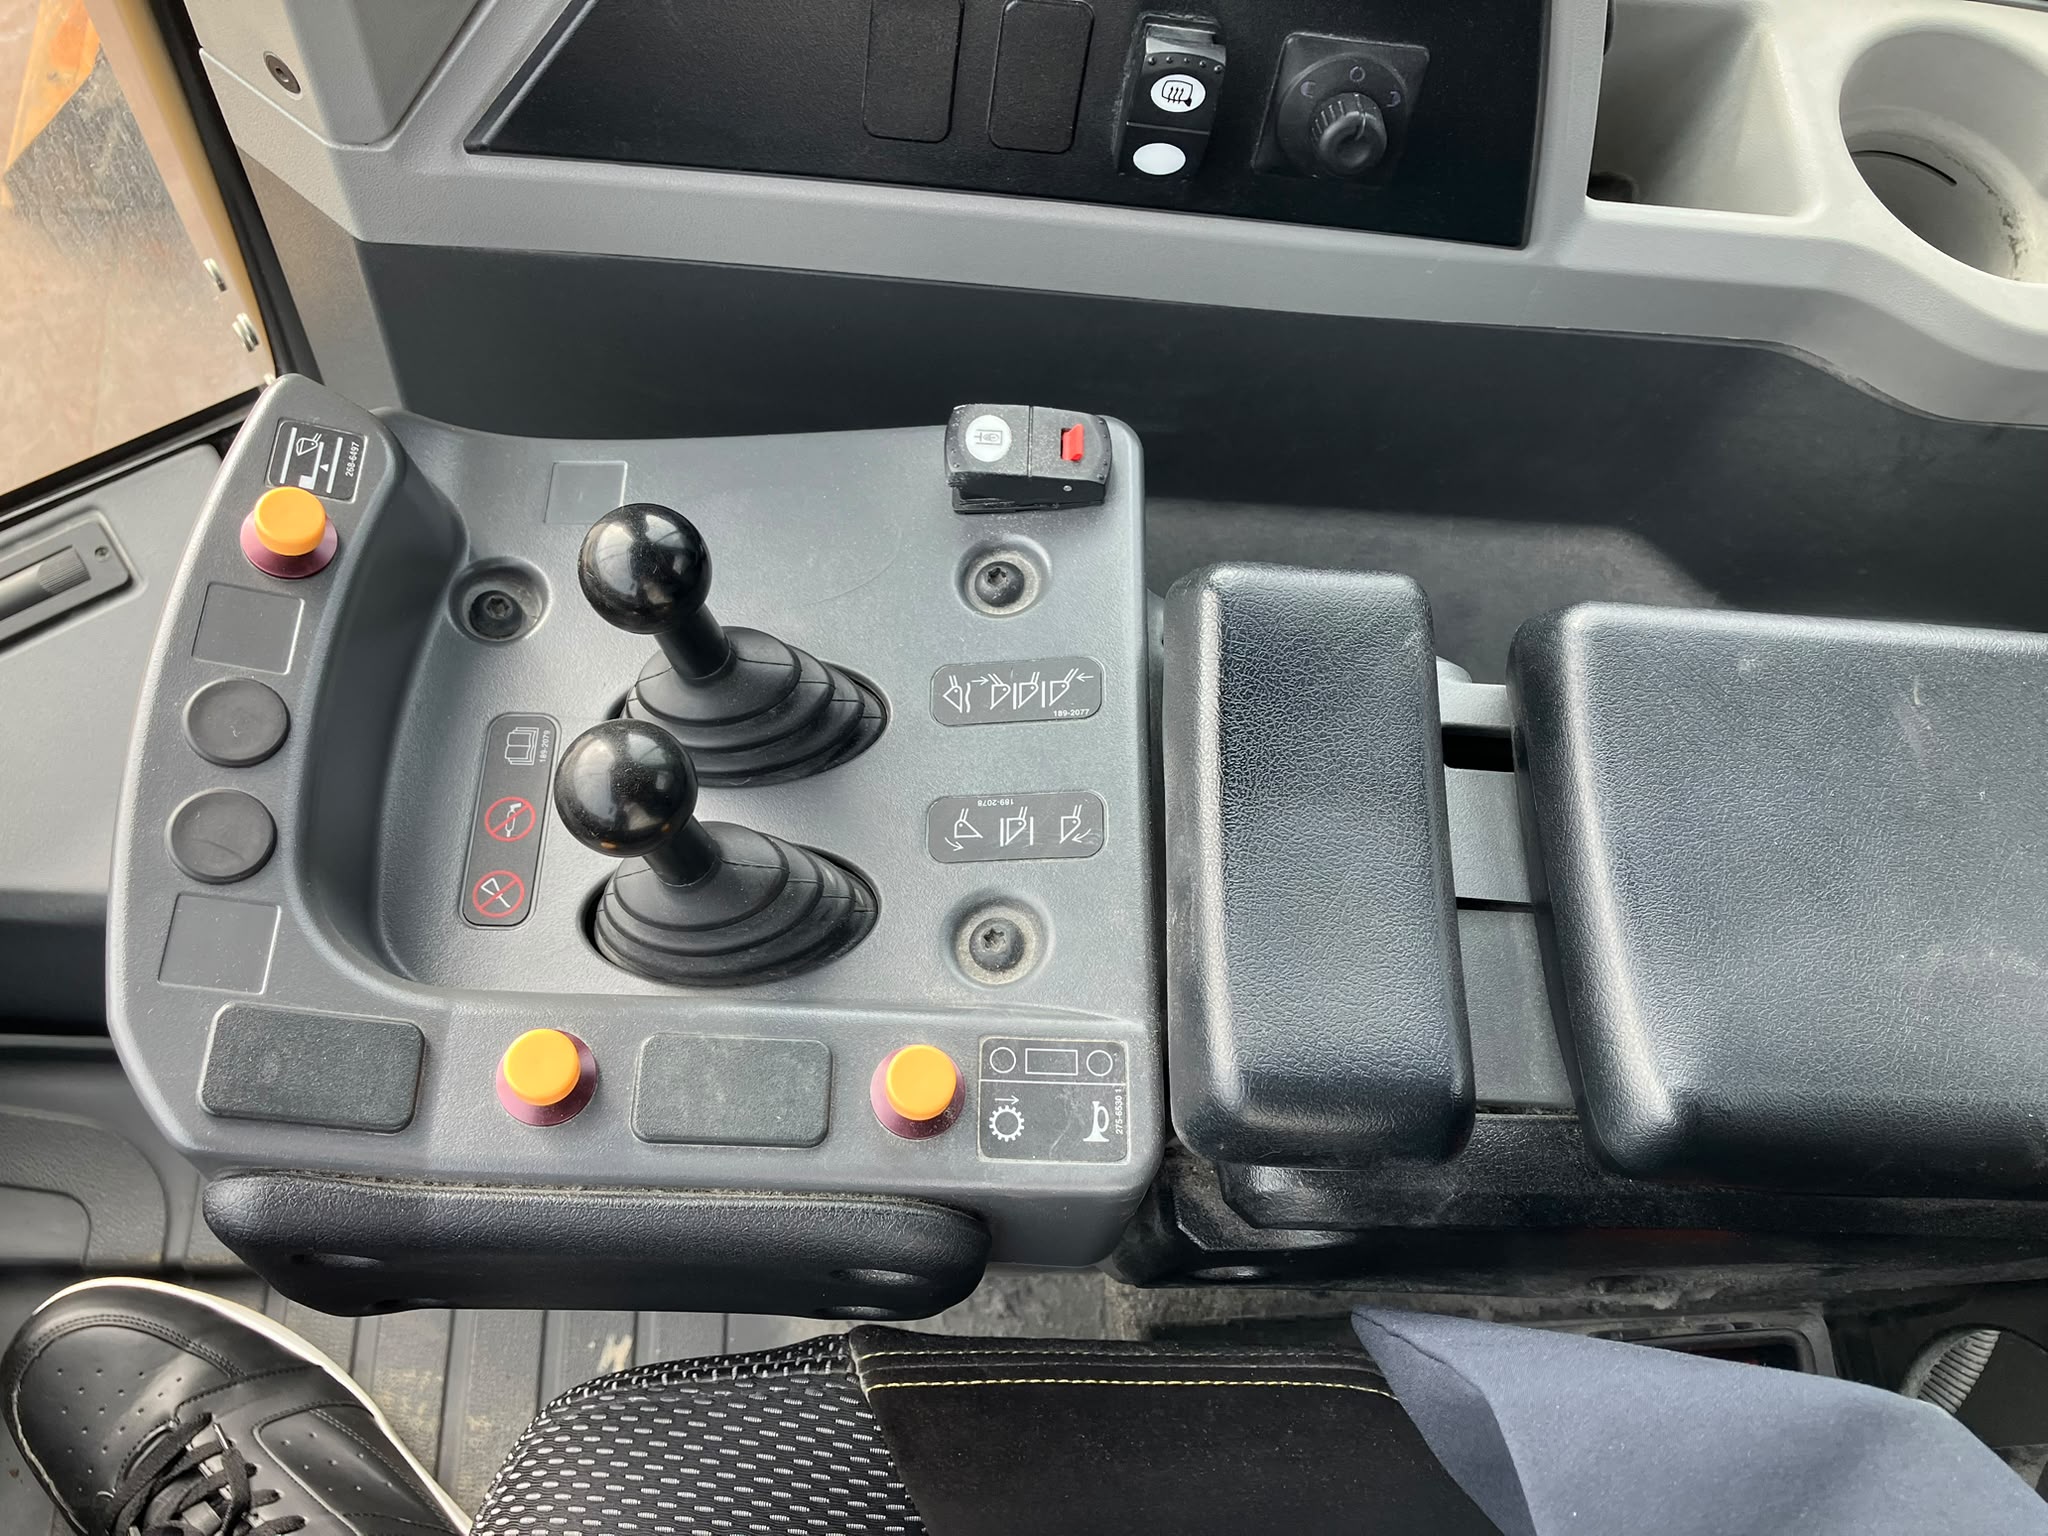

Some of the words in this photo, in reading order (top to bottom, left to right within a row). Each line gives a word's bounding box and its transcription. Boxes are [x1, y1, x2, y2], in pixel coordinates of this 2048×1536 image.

[345, 441, 360, 477] 268-6497
[1053, 708, 1090, 717] 189-2077
[977, 798, 1014, 807] 189-2078
[1114, 1095, 1124, 1135] 275-6530
